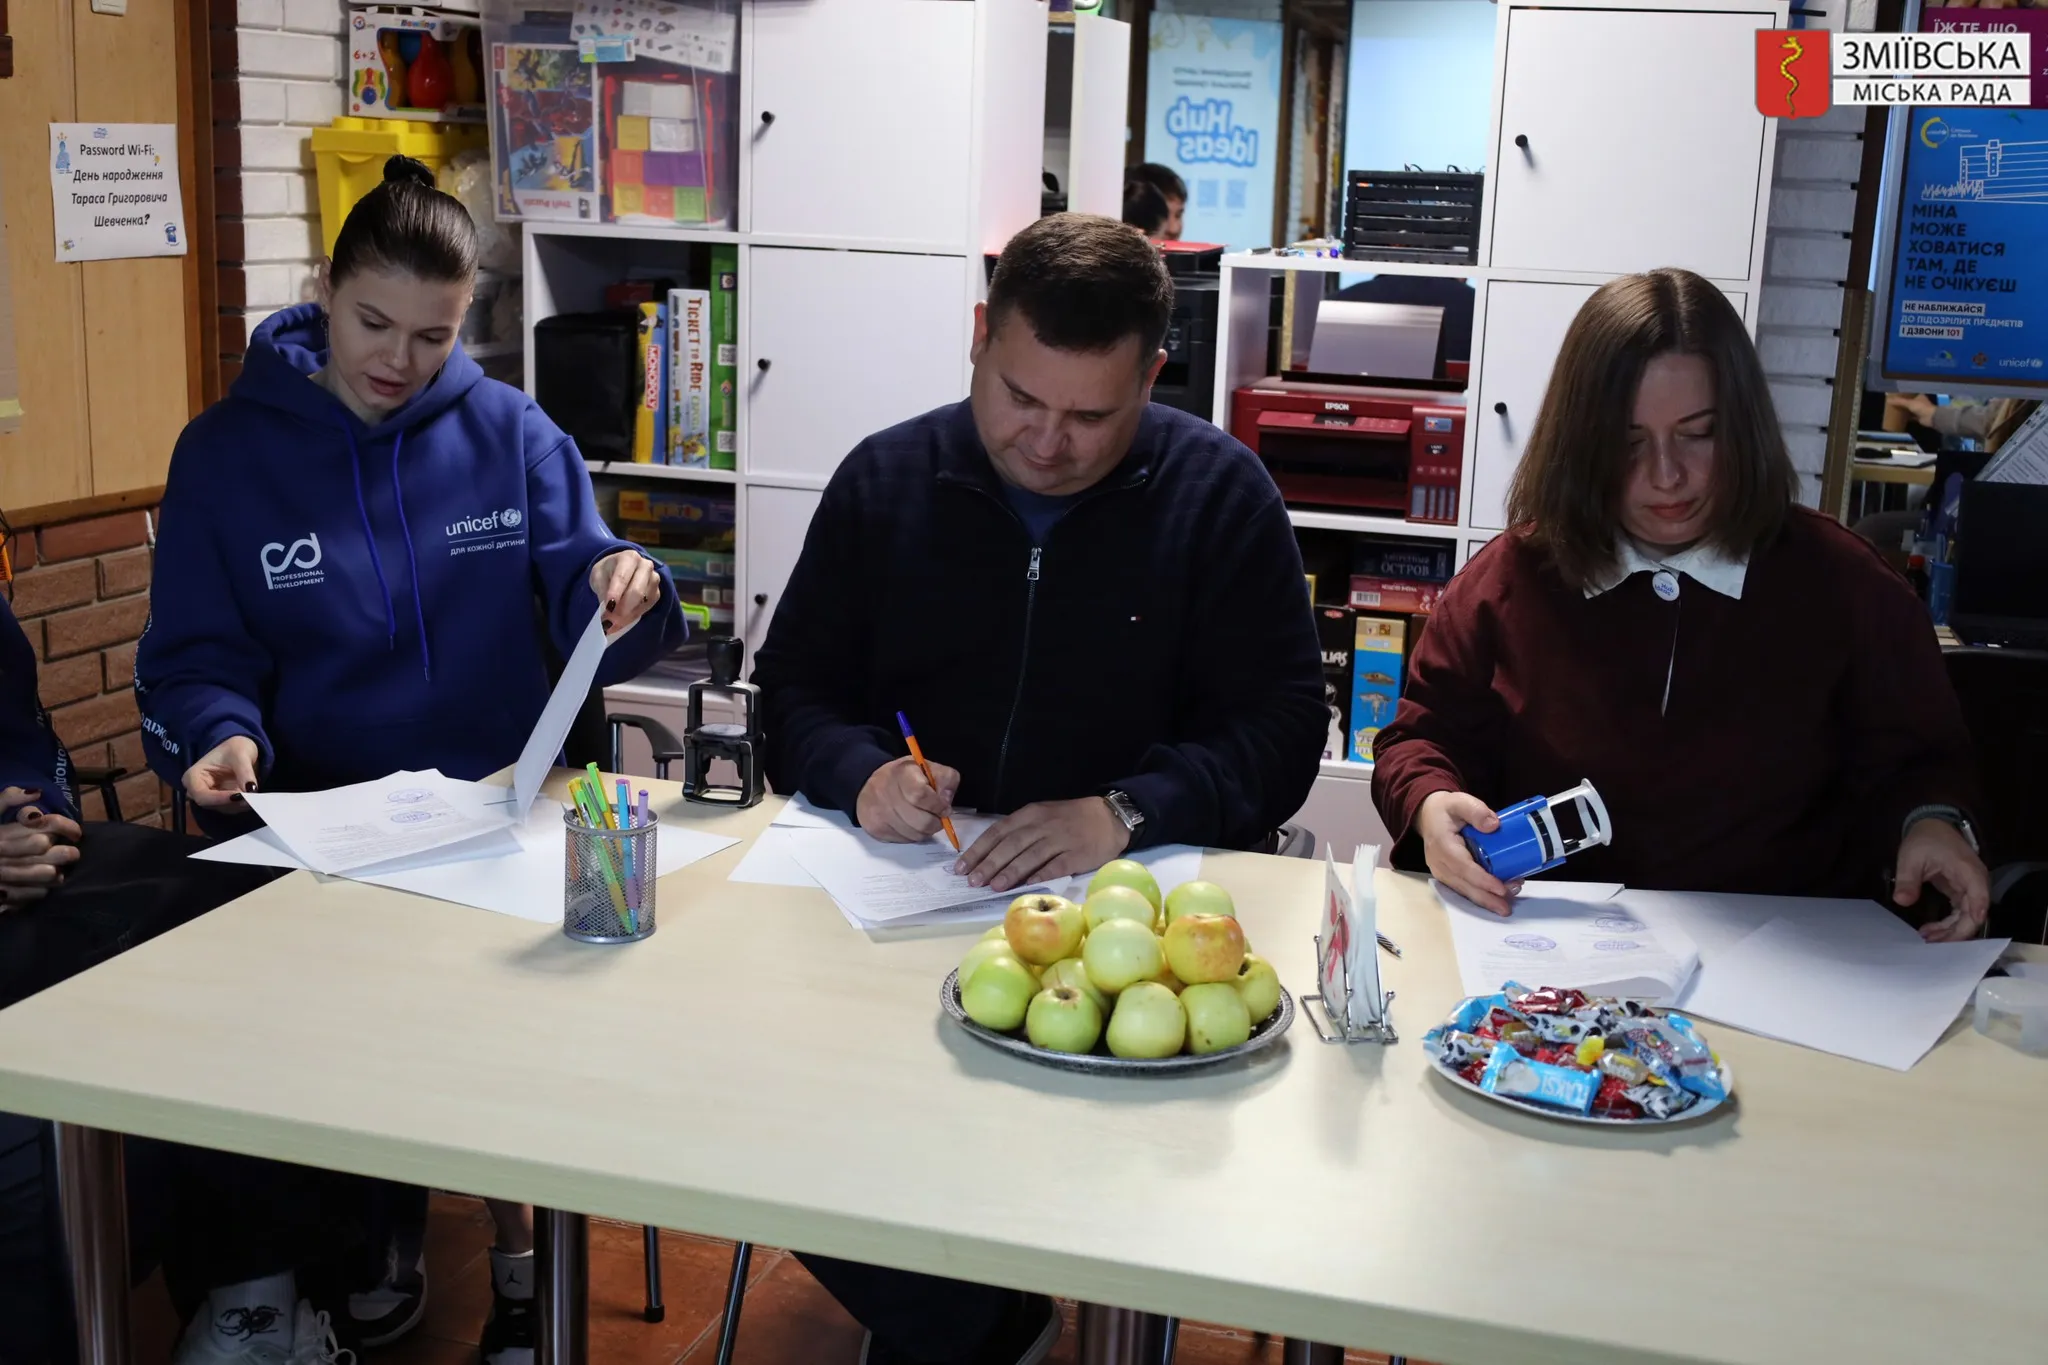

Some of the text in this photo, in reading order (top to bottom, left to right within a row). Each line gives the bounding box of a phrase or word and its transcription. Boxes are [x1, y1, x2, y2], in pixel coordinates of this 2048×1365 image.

[80, 144, 155, 156] Password Wi-Fi:
[73, 169, 163, 183] День народження
[72, 192, 168, 206] Тараса Григоровича
[1912, 204, 1957, 218] МІНА
[94, 214, 151, 227] Шевченка?
[1910, 222, 1967, 237] МОЖЕ
[1907, 240, 2005, 256] ХОВАТИСЯ
[1907, 258, 1977, 275] ТАМ, ДЕ
[1904, 275, 2017, 292] НЕ ОЧІКУЄШ
[1904, 303, 1983, 314] НЕ НАБЛИЖАЙСЯ
[688, 297, 703, 344] TICKET
[1901, 315, 2024, 328] ДО ПІДОЗРІЛИХ ПРЕДМЕТІВ
[1907, 327, 1944, 336] ДЗВОНИ
[1947, 328, 1960, 336] 101
[1999, 357, 2030, 368] unicef
[647, 345, 660, 410] MONOPOLY
[689, 362, 704, 392] RIDE
[1325, 402, 1349, 411] EPSON
[445, 510, 499, 536] unicef
[450, 538, 526, 557] для кожної дитини
[1381, 561, 1429, 576] ОСТРОВ
[272, 570, 325, 582] PROFESSIONAL
[274, 577, 325, 589] DEVELOPMENT
[1321, 650, 1349, 667] LIAS
